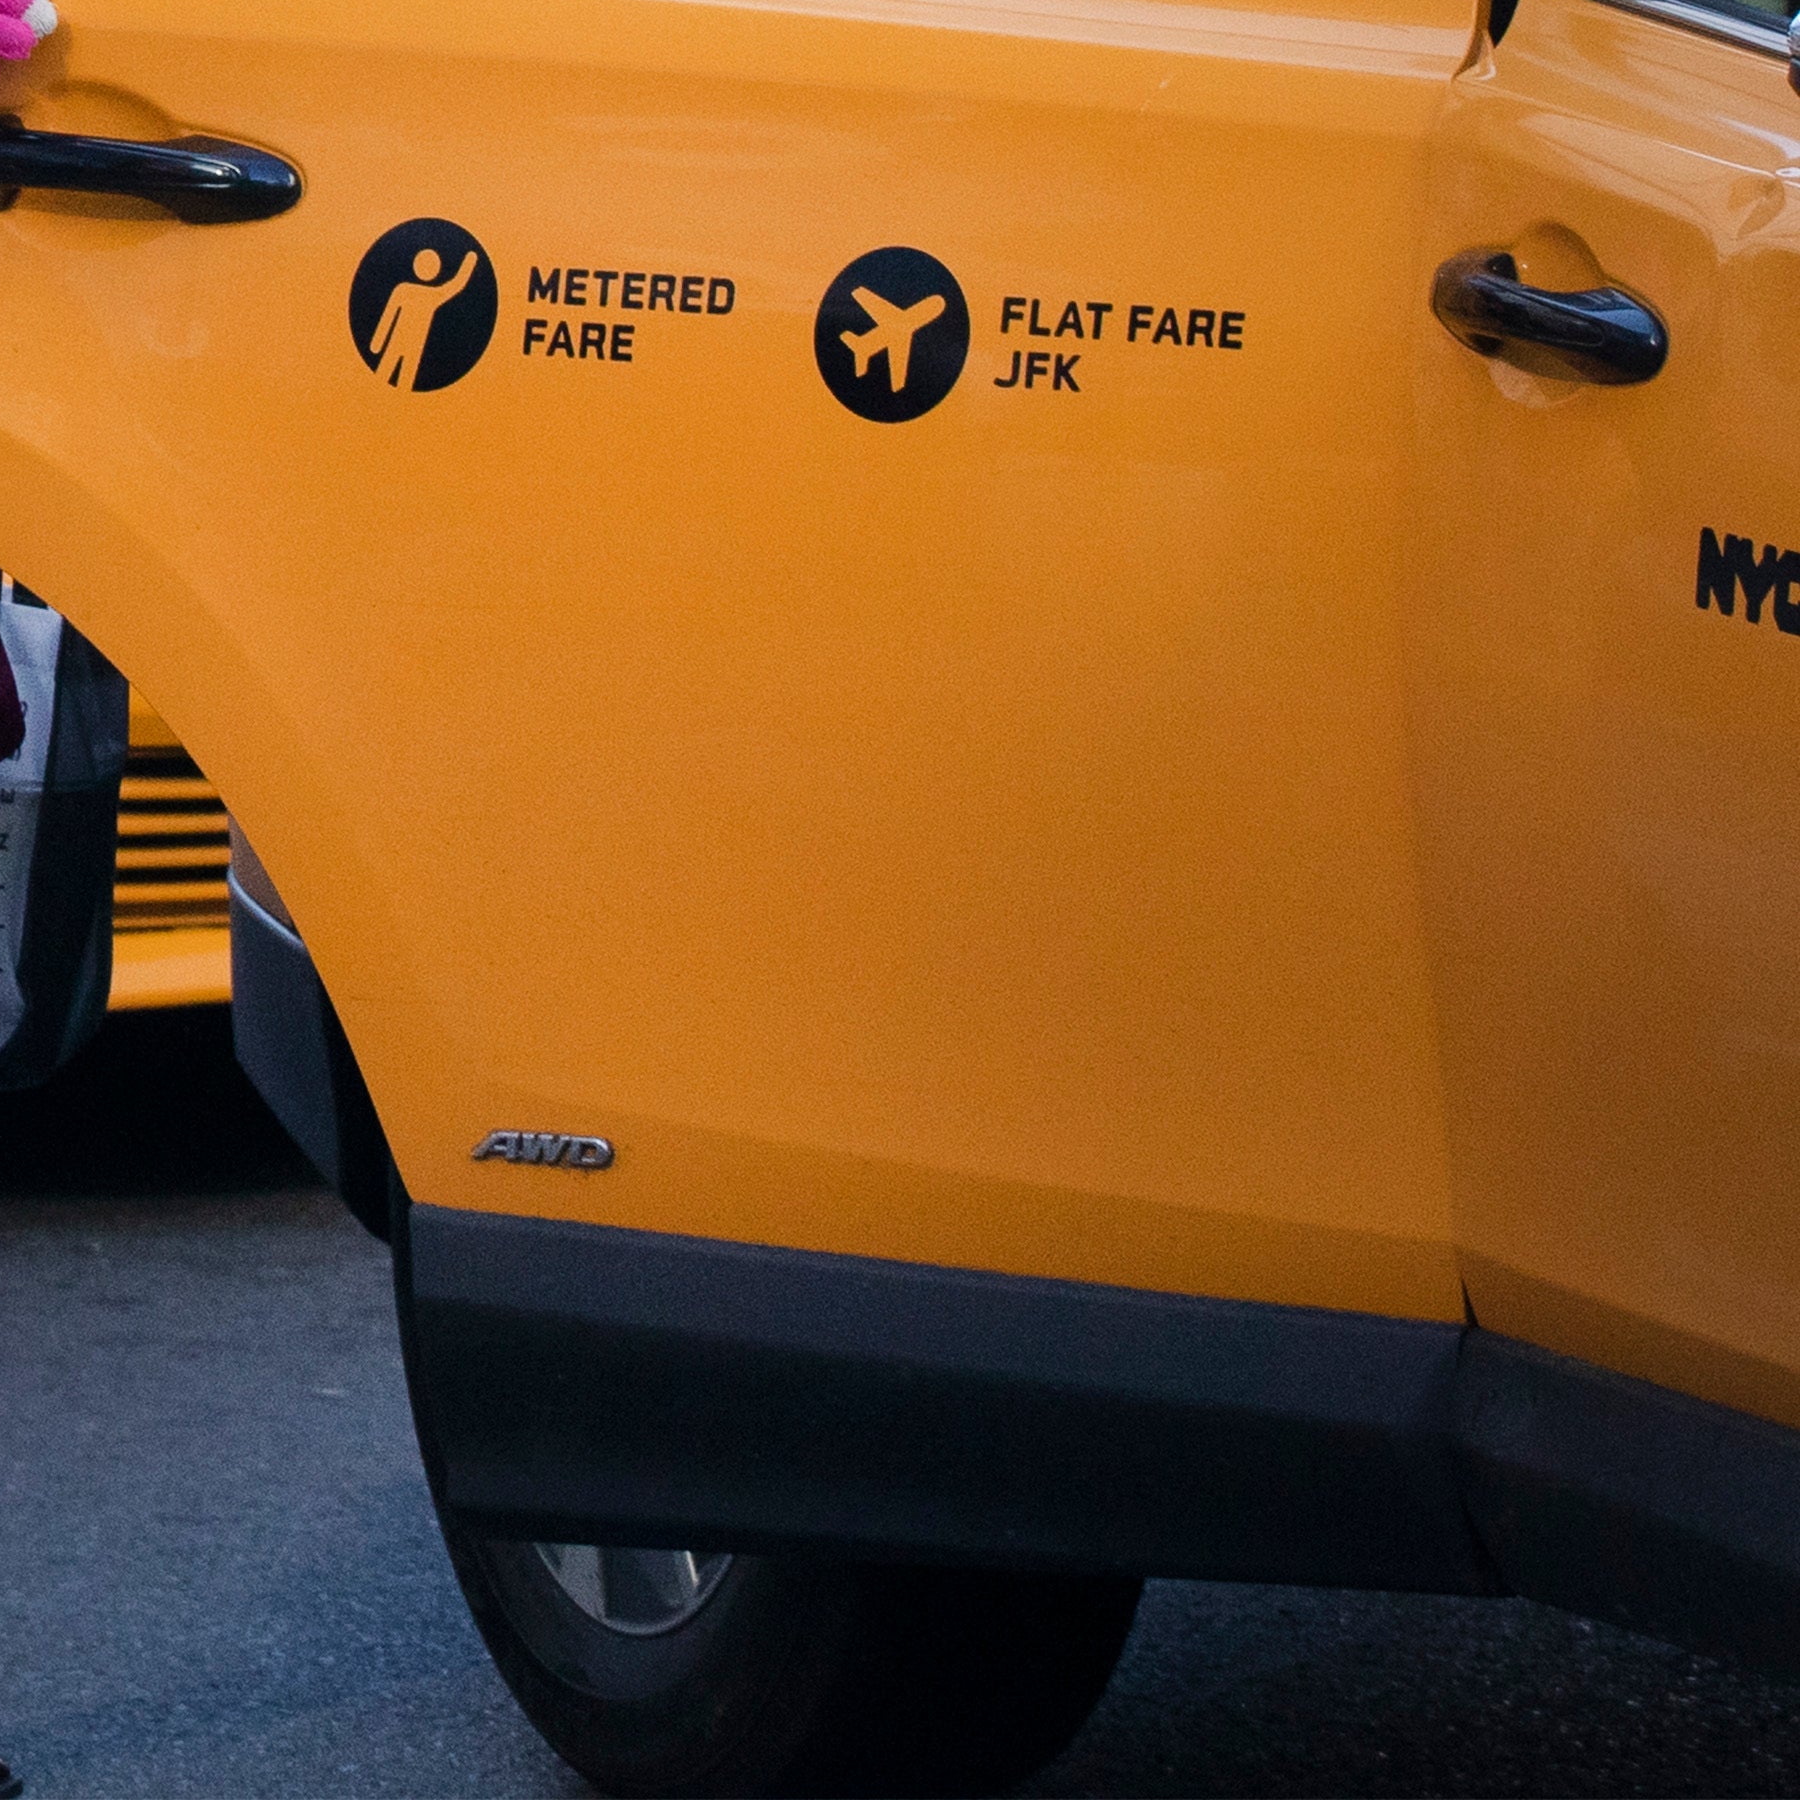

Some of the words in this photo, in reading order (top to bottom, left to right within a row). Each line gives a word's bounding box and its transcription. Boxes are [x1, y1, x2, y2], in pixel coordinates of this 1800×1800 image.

[527, 265, 736, 316] METERED
[523, 318, 635, 362] FARE
[1000, 296, 1113, 341] FLAT
[1127, 304, 1246, 350] FARE
[993, 350, 1081, 393] JFK
[1696, 526, 1800, 638] NYC
[471, 1129, 615, 1171] AWD
